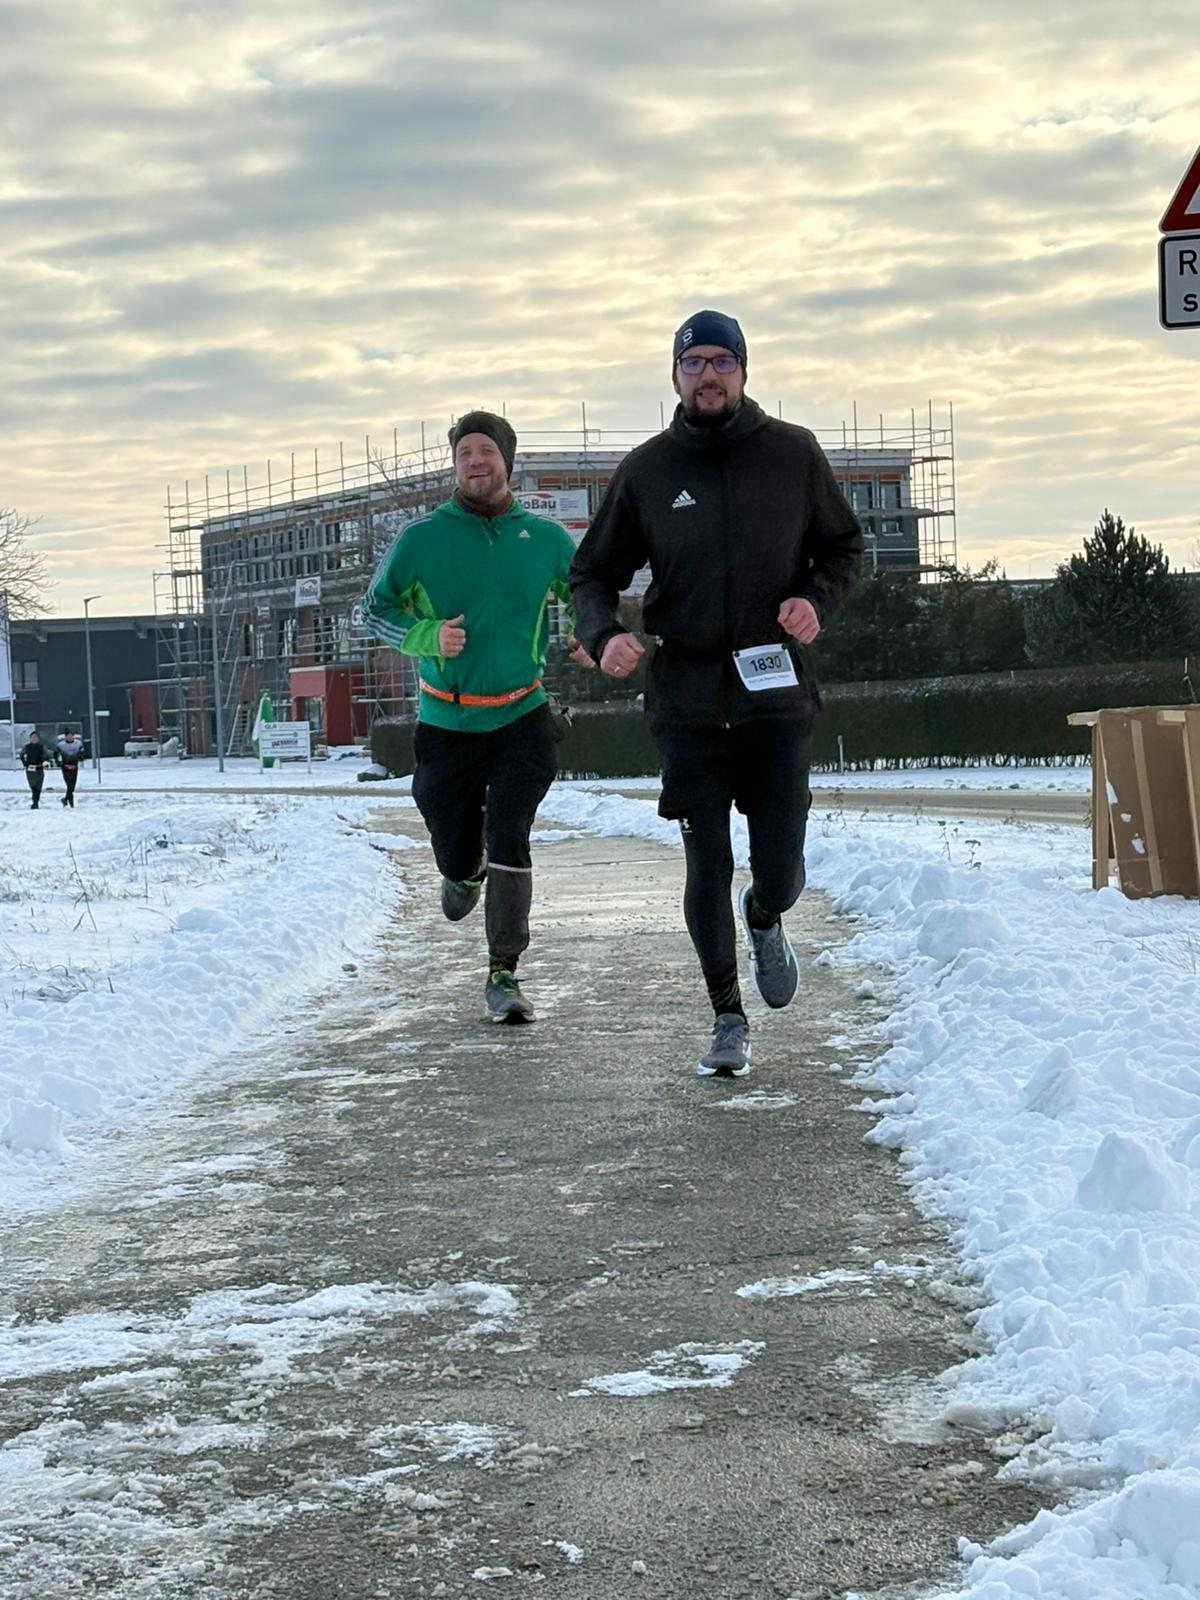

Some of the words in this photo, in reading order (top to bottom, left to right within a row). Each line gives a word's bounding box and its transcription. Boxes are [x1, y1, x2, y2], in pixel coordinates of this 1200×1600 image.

[1179, 249, 1198, 275] R
[518, 498, 556, 510] oBau
[750, 655, 782, 672] 1830
